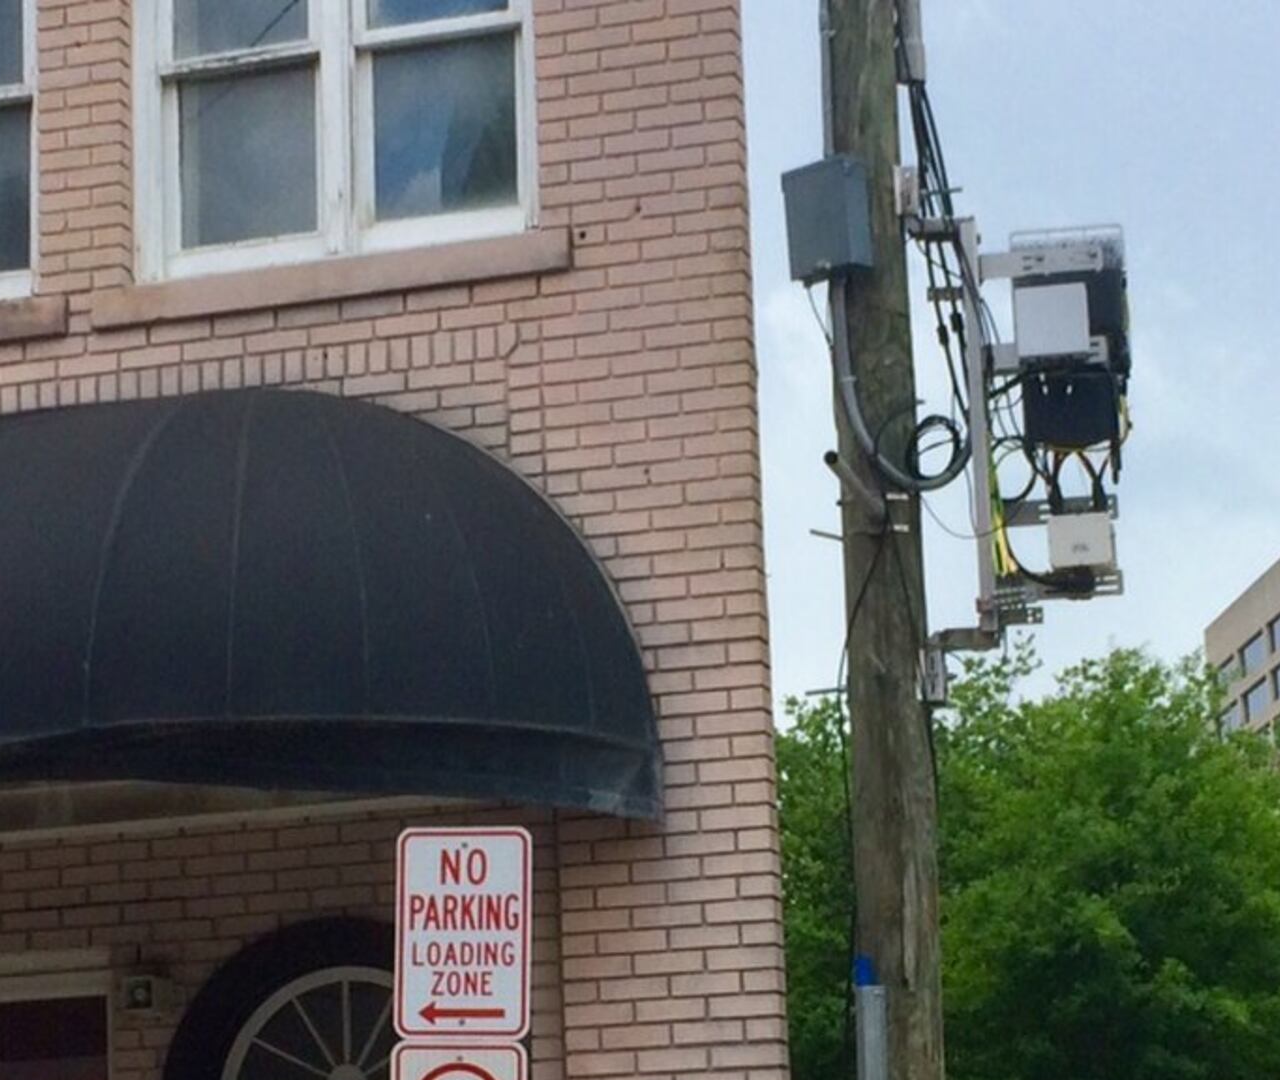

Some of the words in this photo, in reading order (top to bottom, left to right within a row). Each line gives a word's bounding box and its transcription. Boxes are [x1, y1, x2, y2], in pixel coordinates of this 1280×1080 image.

[440, 848, 487, 886] NO
[409, 894, 519, 931] PARKING
[412, 941, 515, 966] LOADING
[431, 971, 493, 996] ZONE
